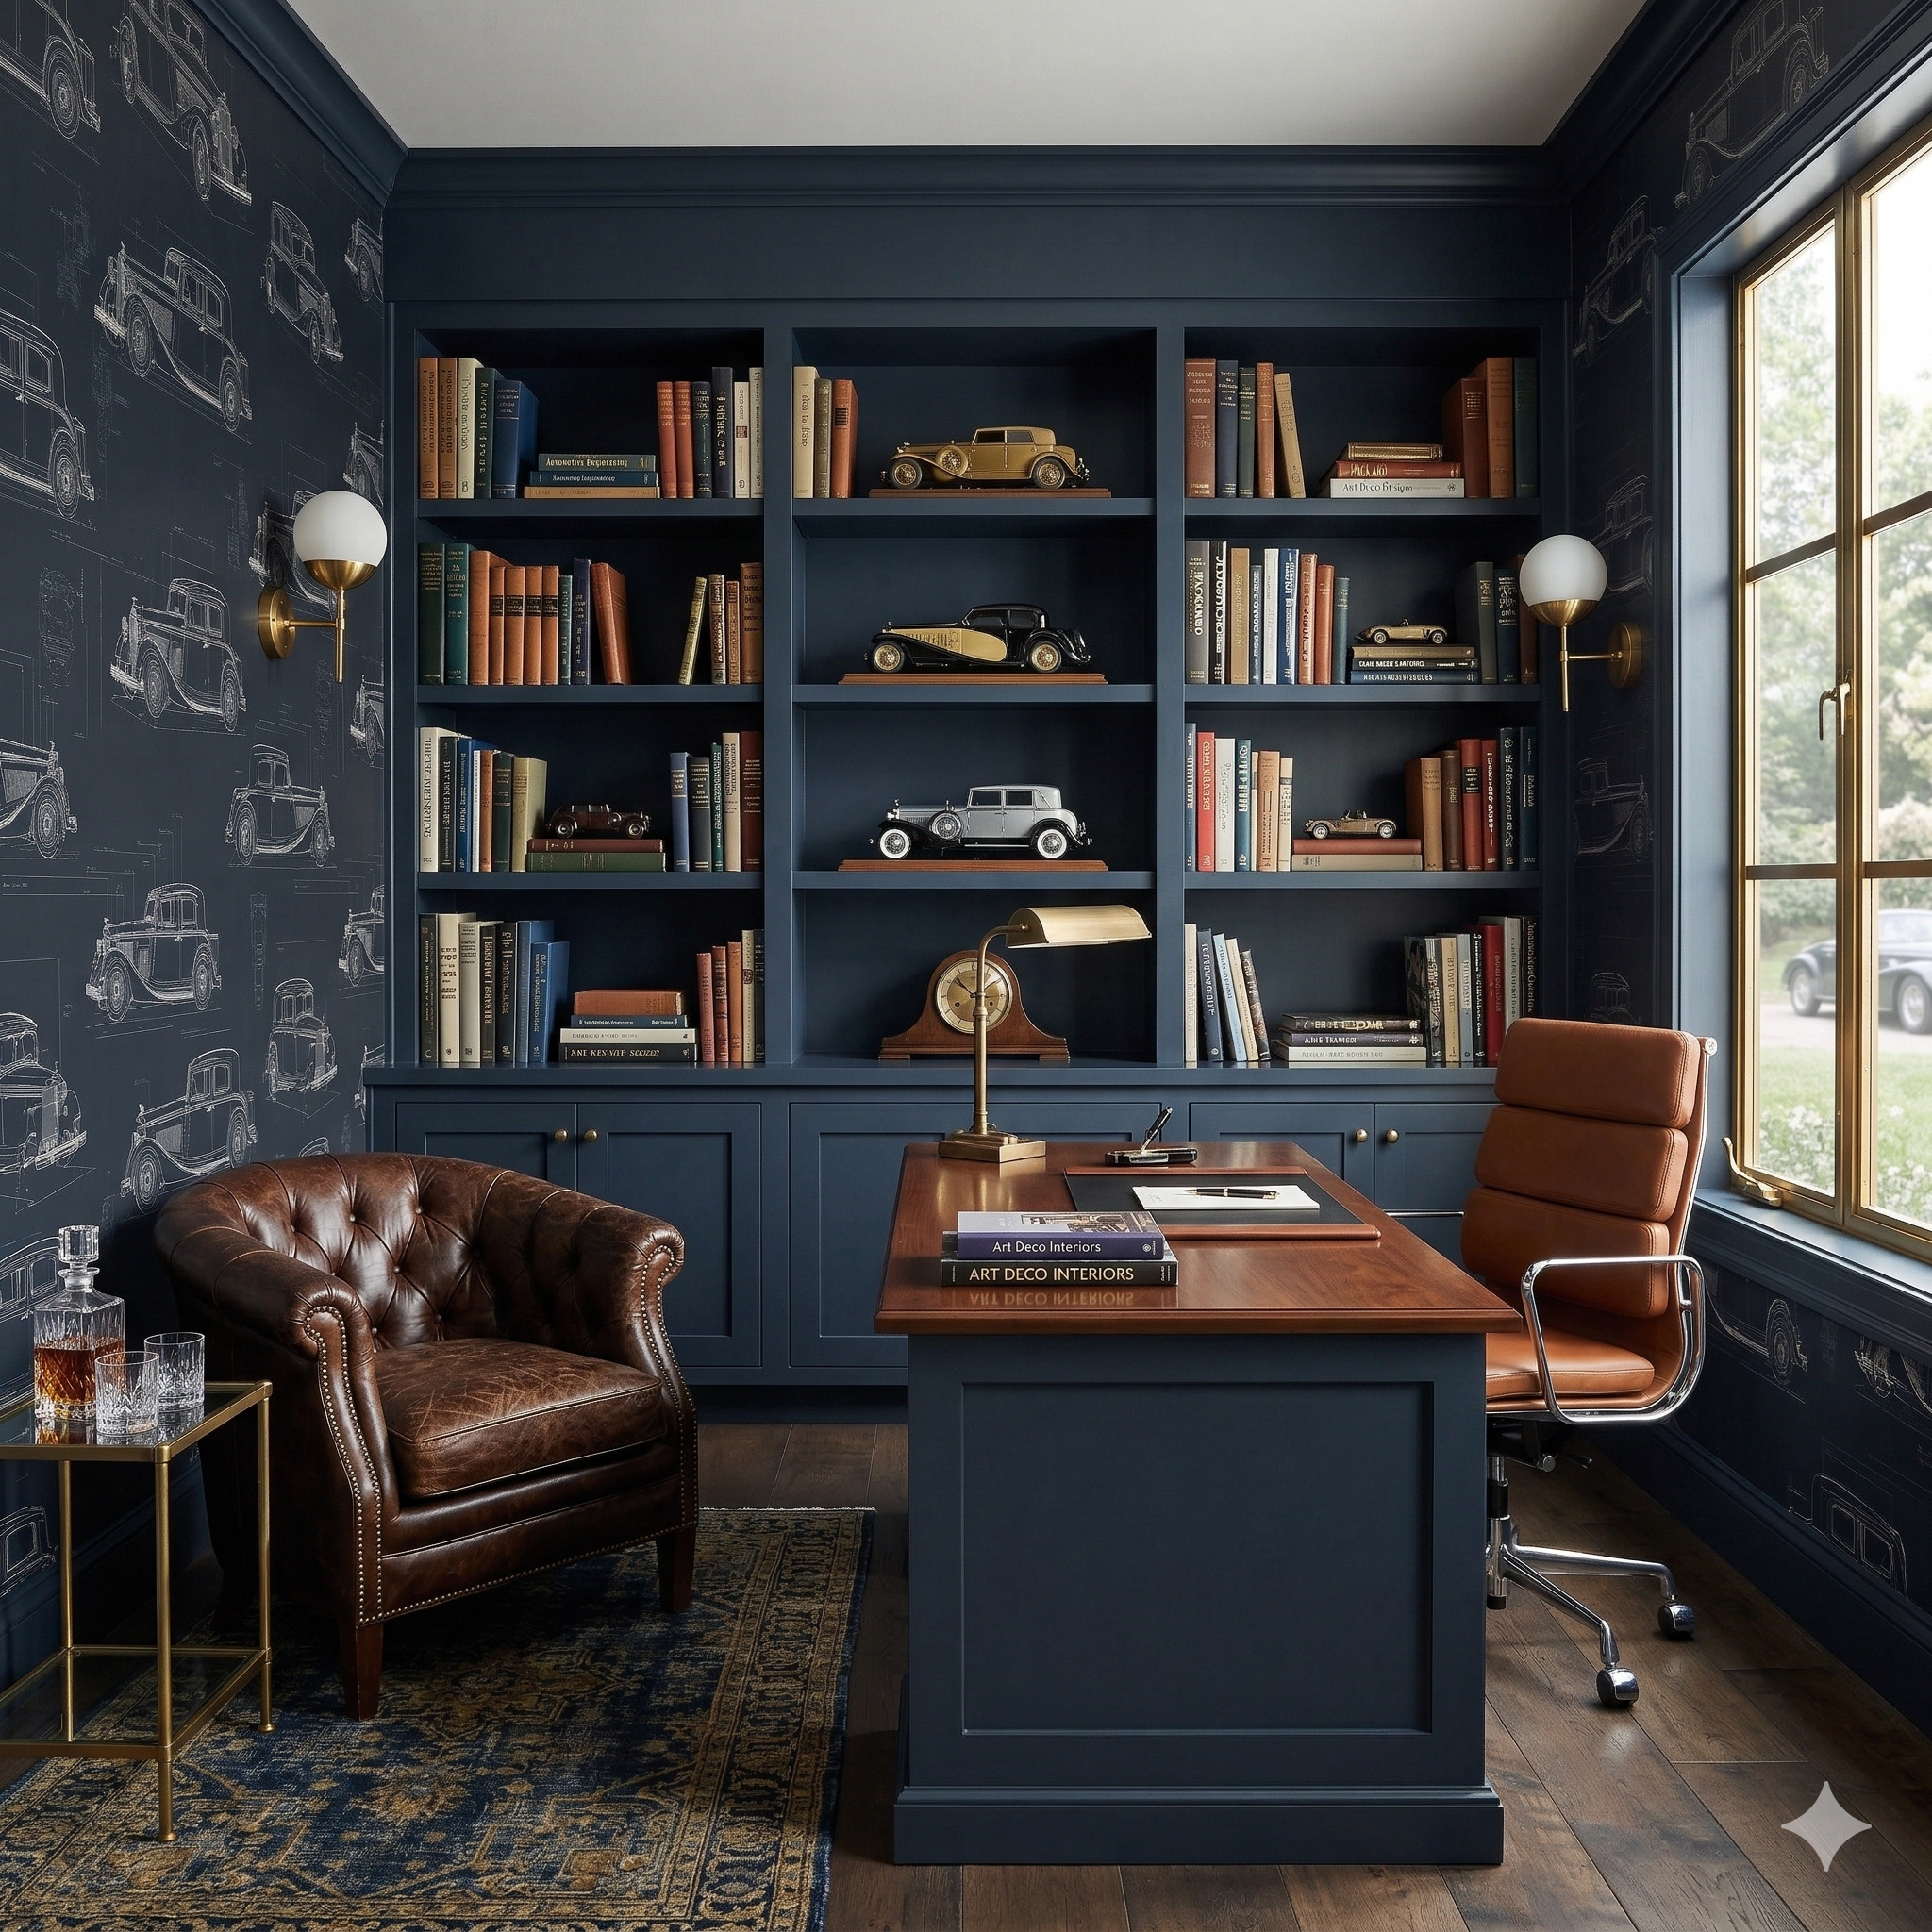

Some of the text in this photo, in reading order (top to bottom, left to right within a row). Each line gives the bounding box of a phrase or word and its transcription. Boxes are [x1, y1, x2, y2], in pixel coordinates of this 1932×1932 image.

[992, 1241, 1101, 1253] Art Deco Interiors
[969, 1267, 1134, 1281] ART DECO INTERIORS
